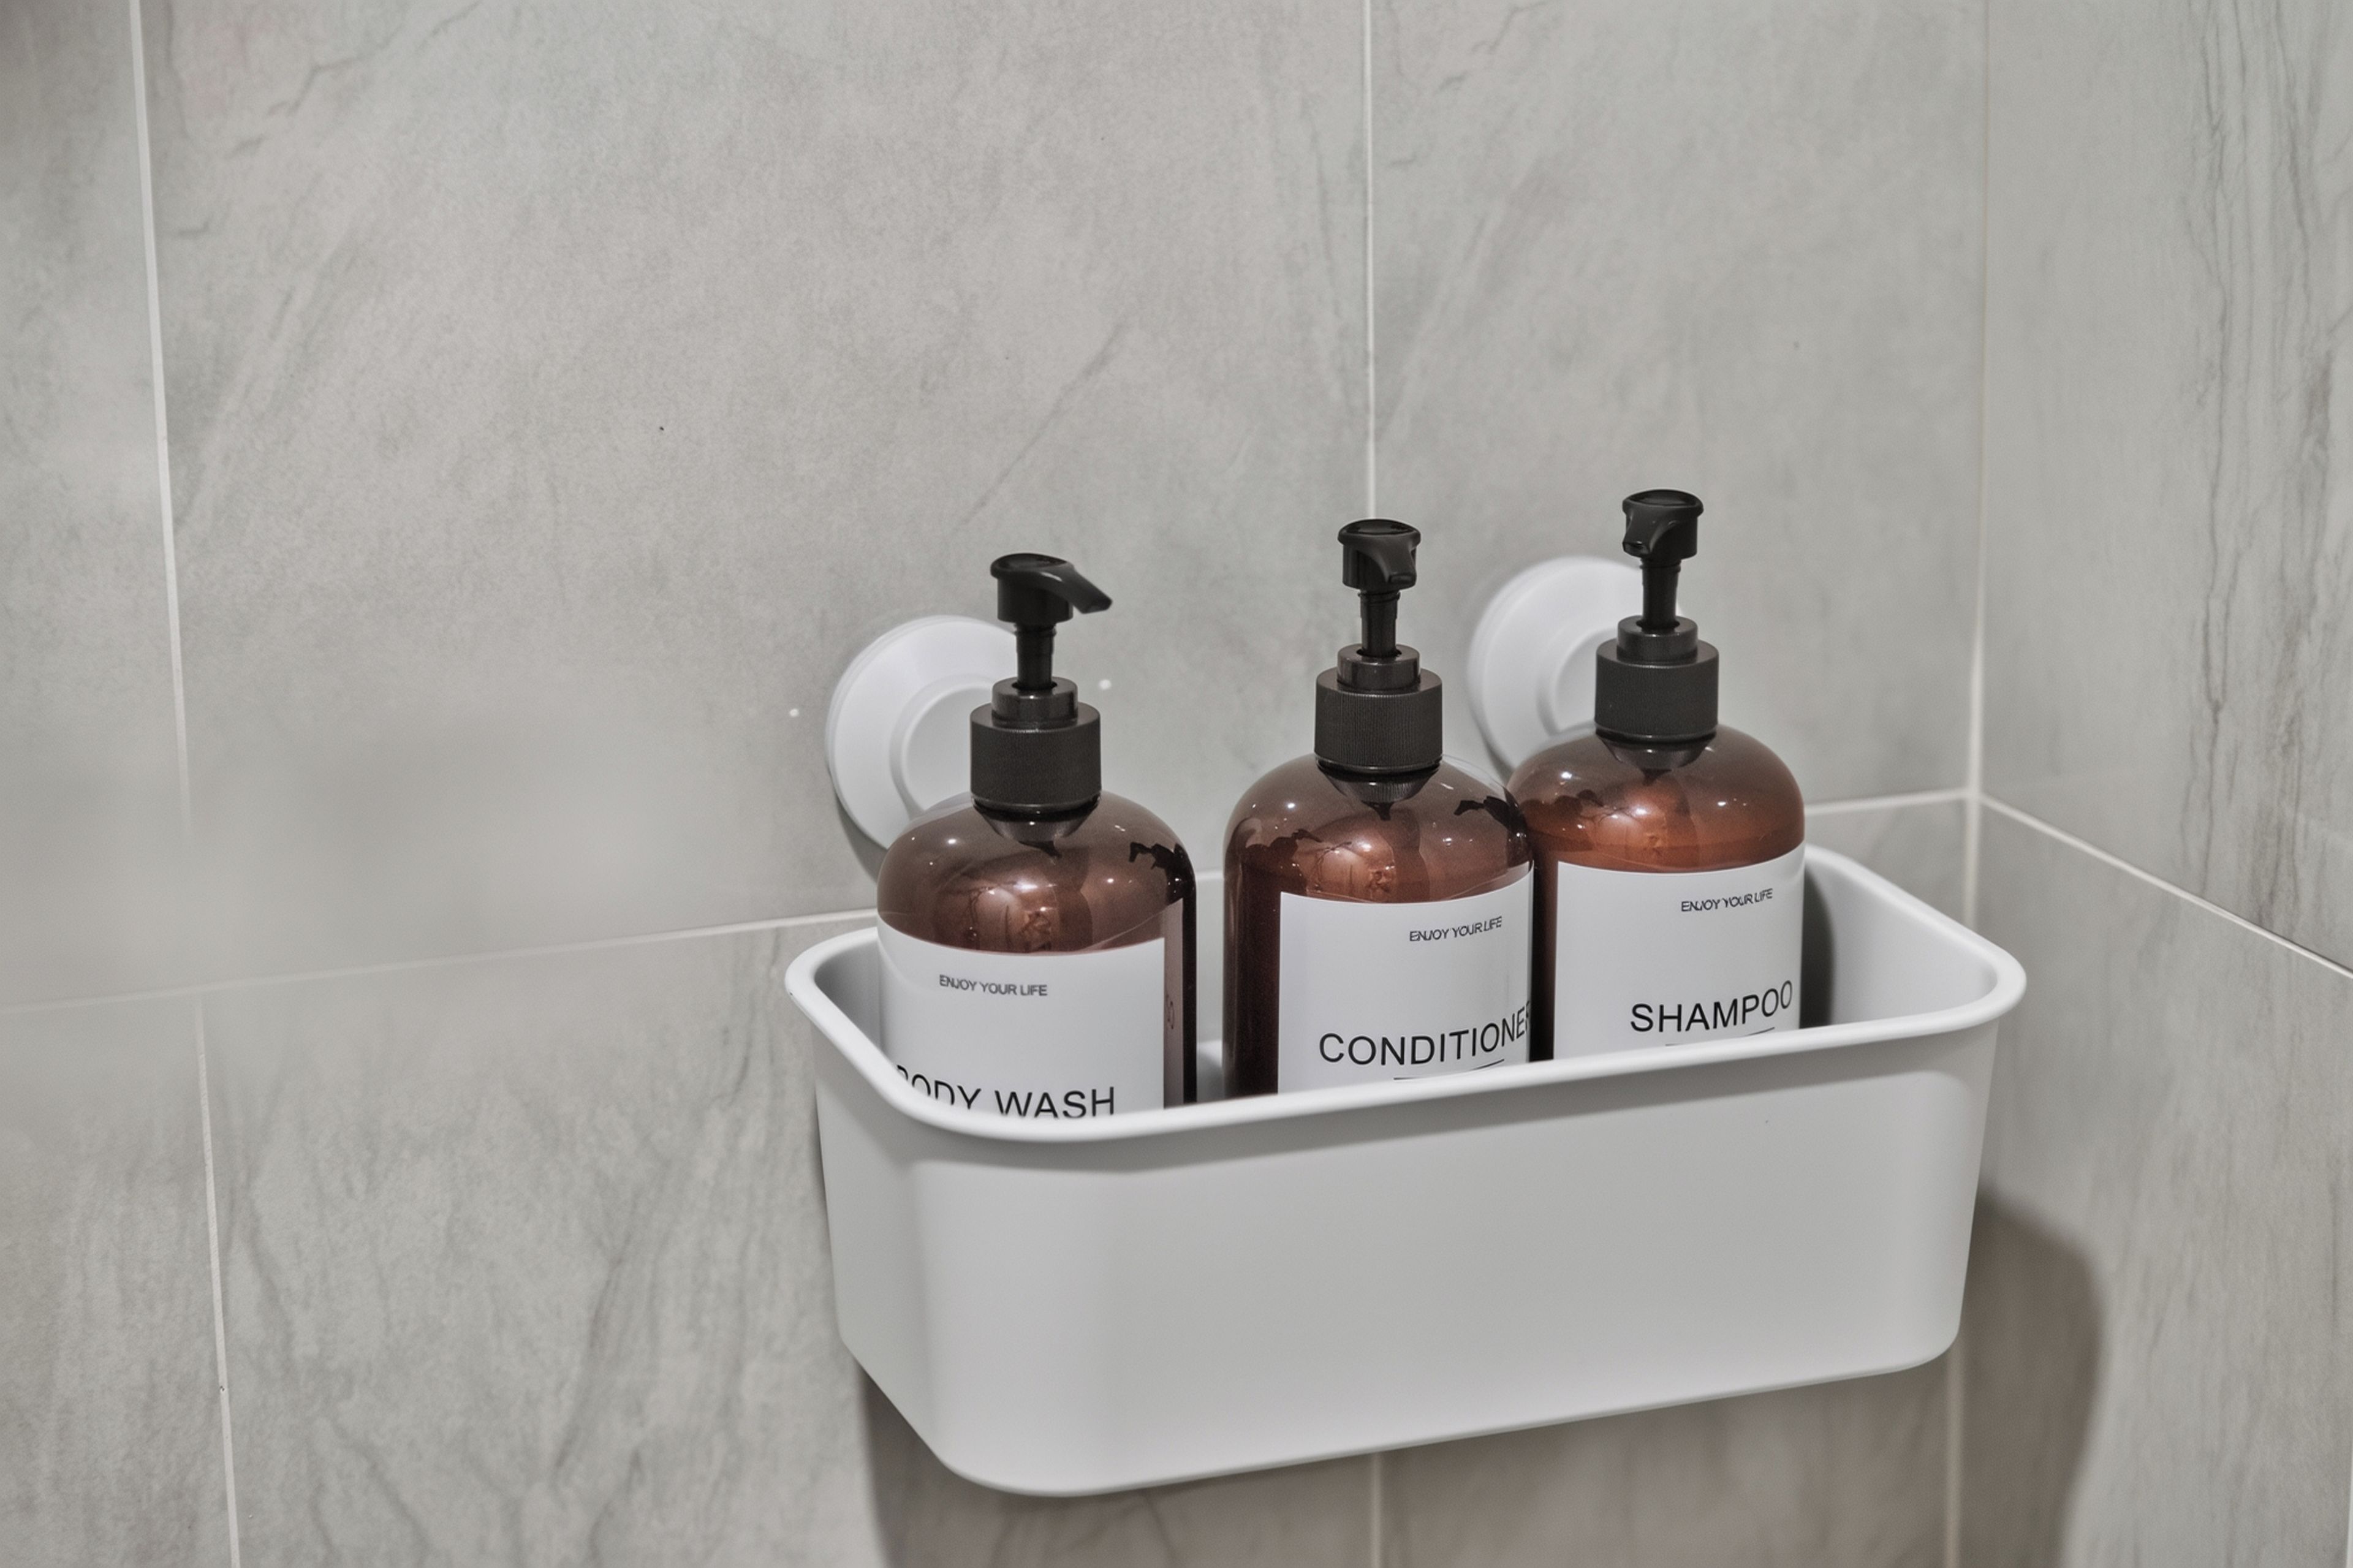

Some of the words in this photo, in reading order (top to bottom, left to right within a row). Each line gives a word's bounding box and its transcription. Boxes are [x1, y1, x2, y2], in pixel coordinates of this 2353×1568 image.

[1681, 899, 1721, 912] ENJOY
[1722, 893, 1754, 909] YOUR
[1754, 888, 1773, 901] LIFE
[1409, 929, 1450, 942] ENJOY
[1452, 922, 1483, 938] YOUR
[1483, 916, 1502, 930] LIFE
[939, 974, 977, 991] ENJOY
[981, 981, 1017, 996] YOUR
[1020, 984, 1047, 996] LIFE
[1631, 980, 1793, 1032] SHAMPOO
[995, 1086, 1115, 1119] WASH
